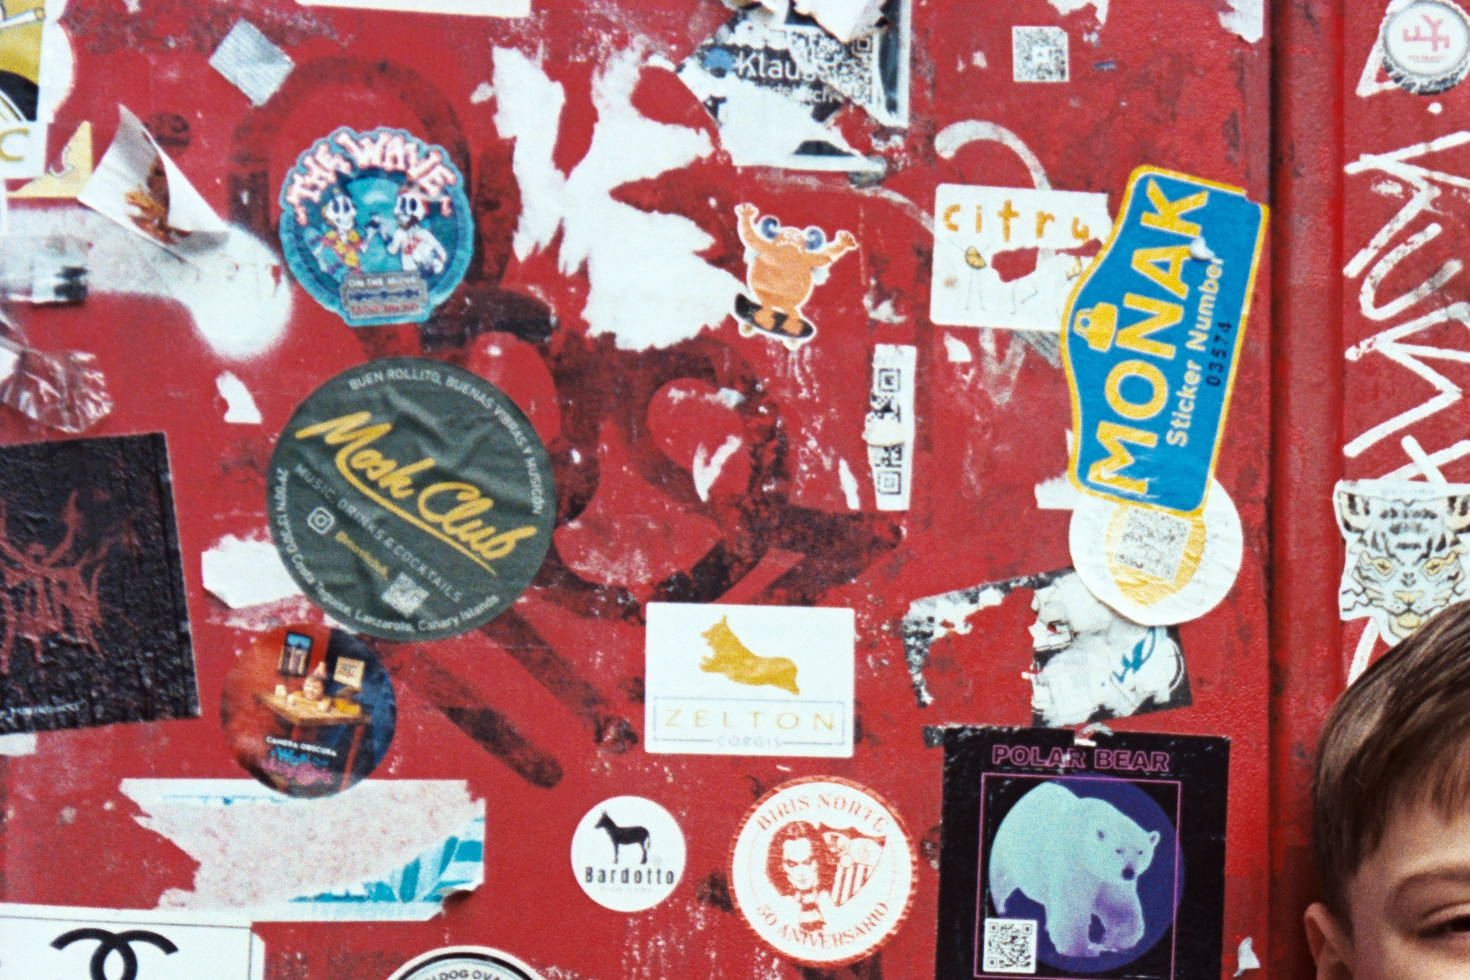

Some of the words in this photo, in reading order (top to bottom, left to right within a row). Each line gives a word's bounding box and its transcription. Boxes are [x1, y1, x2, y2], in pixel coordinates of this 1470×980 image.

[287, 144, 351, 226] THE
[335, 132, 456, 216] WAVE
[1087, 178, 1210, 495] MONAK
[1166, 360, 1202, 447] Sticker
[1186, 257, 1224, 352] Number
[1206, 320, 1232, 387] 03574
[348, 371, 384, 391] BUEN
[445, 376, 496, 409] BUENAS
[494, 404, 527, 446] VIBRAS
[295, 411, 436, 499] Mosh
[418, 482, 537, 559] Club
[337, 499, 386, 539] DRINKS
[393, 545, 463, 602] COCKTAILS
[664, 709, 834, 731] ZELTON
[992, 745, 1087, 769] POLAR
[1094, 749, 1170, 772] BEAR
[756, 796, 811, 831] BIRIS
[817, 793, 889, 833] NORTE
[585, 866, 675, 884] Bardotto
[777, 901, 890, 949] ANIVERSARIO
